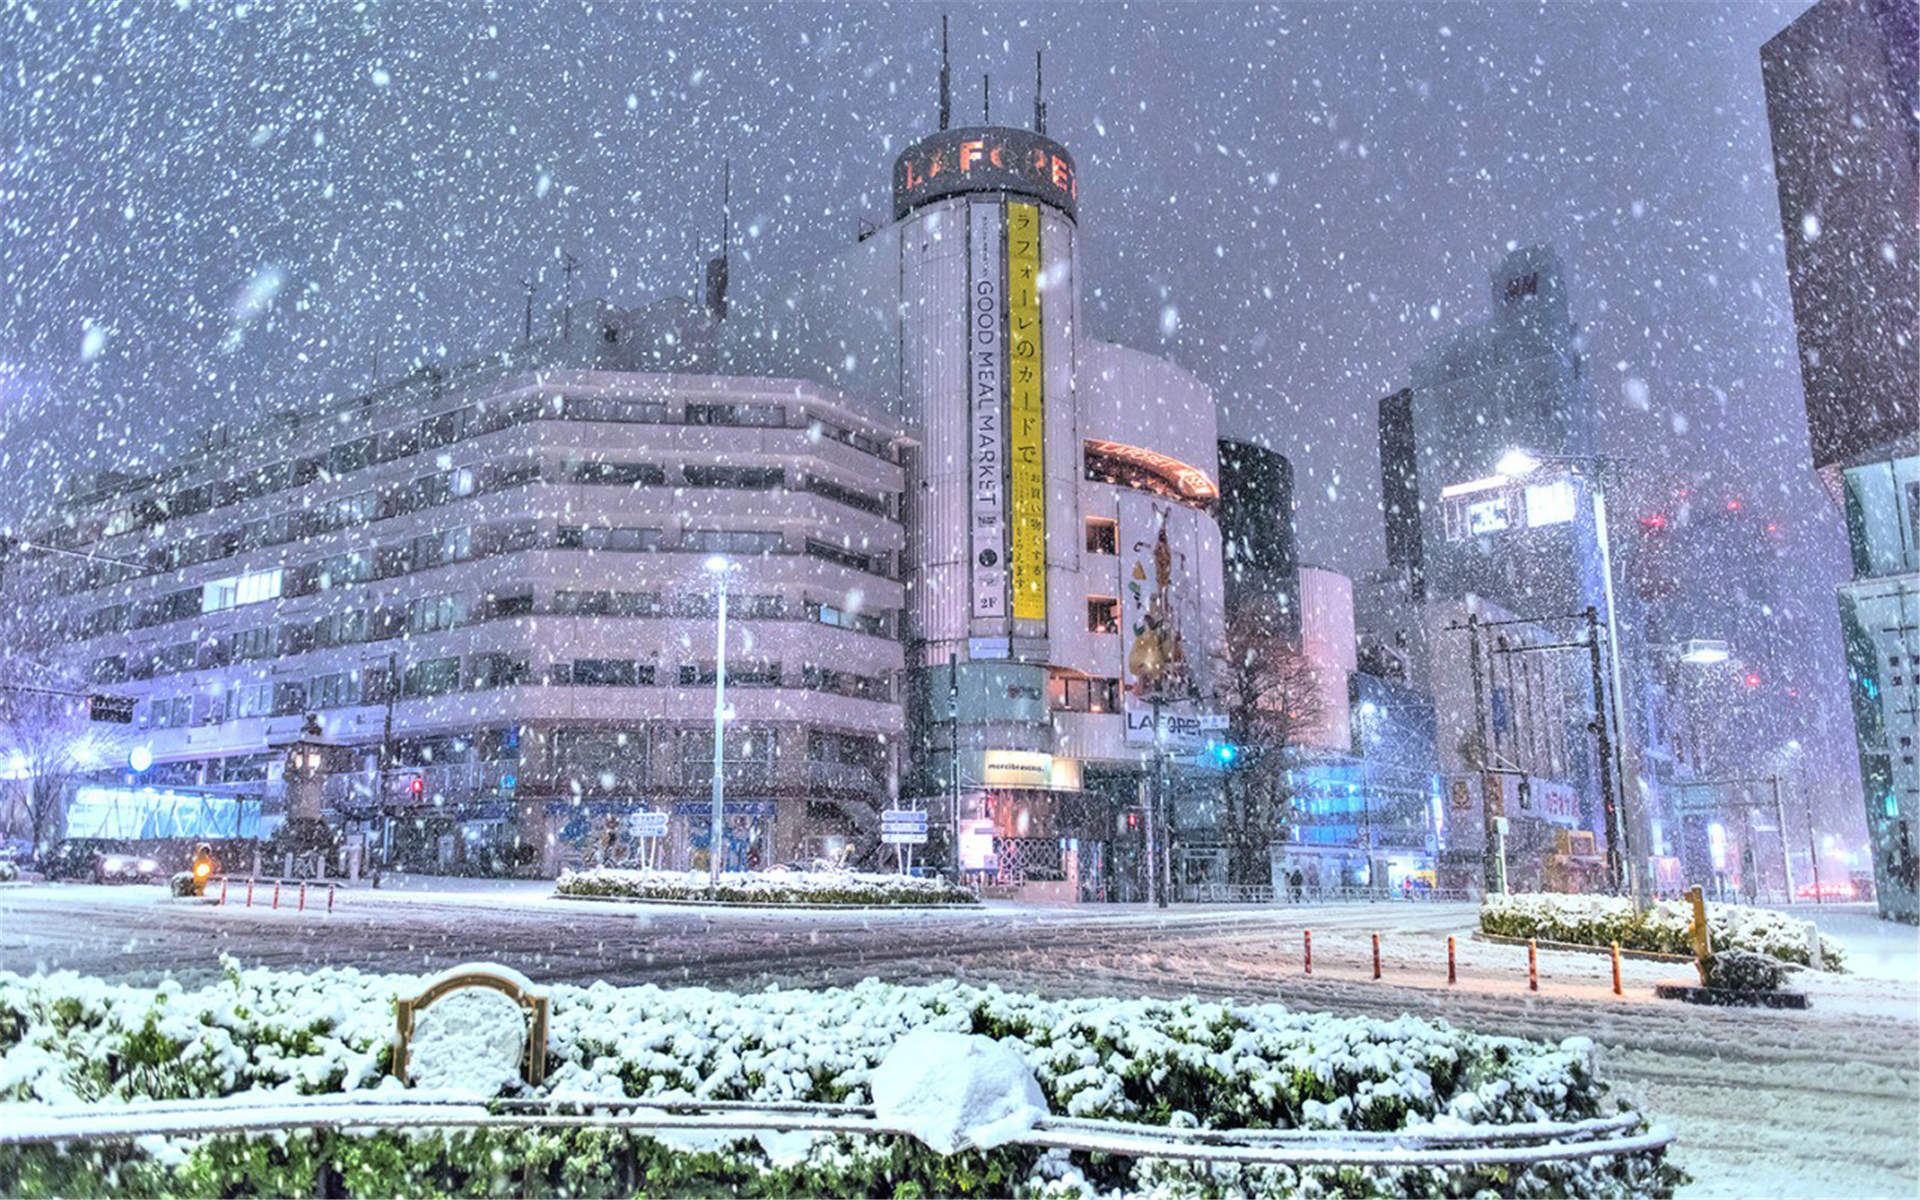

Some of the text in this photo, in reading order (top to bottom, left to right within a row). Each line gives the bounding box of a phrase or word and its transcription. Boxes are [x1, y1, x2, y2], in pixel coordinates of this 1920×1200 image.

[977, 281, 994, 345] GOOD
[1016, 214, 1036, 464] ラフォーレのカードで
[978, 351, 994, 410] MEAL
[979, 414, 996, 505] MARKET
